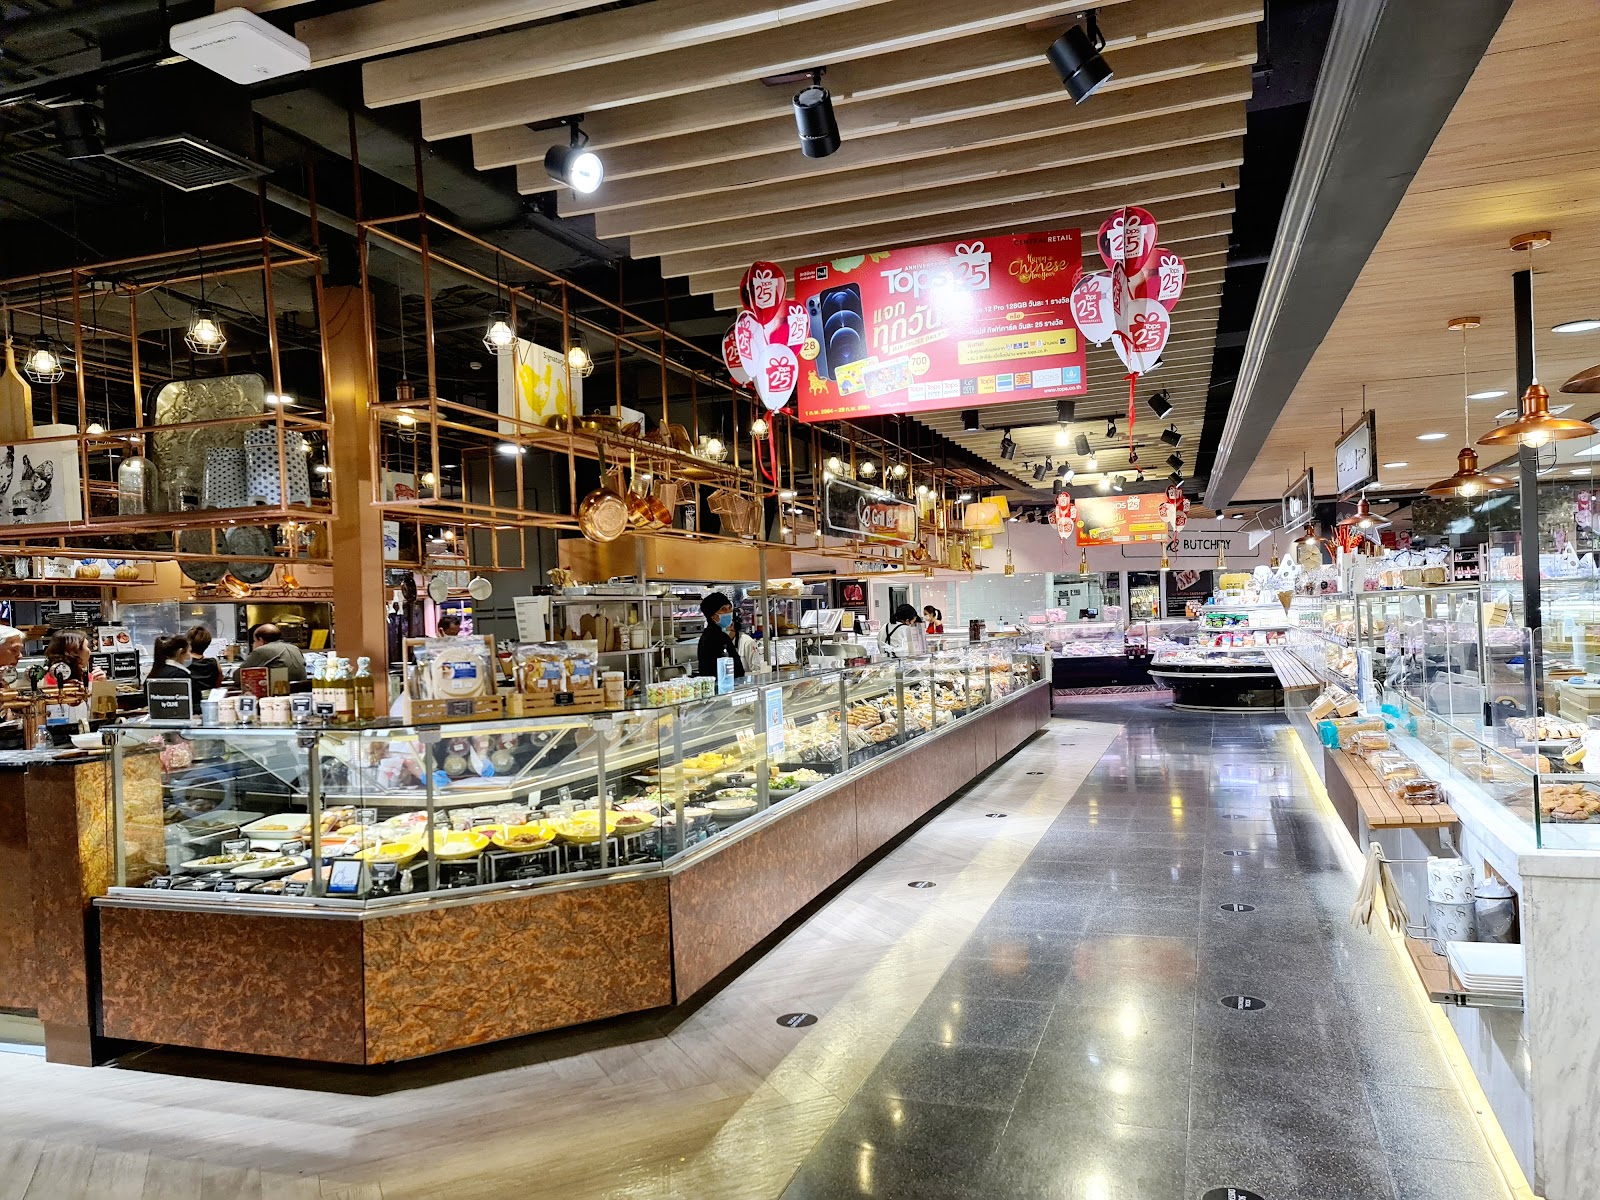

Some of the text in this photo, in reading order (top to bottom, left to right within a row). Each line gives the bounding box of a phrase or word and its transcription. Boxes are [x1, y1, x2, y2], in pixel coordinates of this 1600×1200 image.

[1047, 234, 1073, 243] RETAIL
[1113, 234, 1139, 253] 25
[957, 261, 987, 287] 25
[1008, 257, 1069, 277] Chinese
[880, 266, 946, 299] Tops
[1163, 273, 1180, 294] 25
[756, 285, 773, 303] 25
[873, 301, 905, 325] แจก
[993, 304, 1005, 312] Pro
[1006, 302, 1027, 310] 128GB
[1076, 299, 1097, 319] 25
[790, 321, 804, 340] 25
[1035, 320, 1043, 328] 25
[739, 334, 750, 355] 25
[803, 341, 816, 351] 28
[1133, 329, 1161, 348] 25
[543, 352, 565, 365] Signatur
[911, 356, 928, 367] 700
[769, 369, 791, 388] 25
[1044, 385, 1082, 394] www.tops.co.th
[1128, 501, 1139, 510] 25
